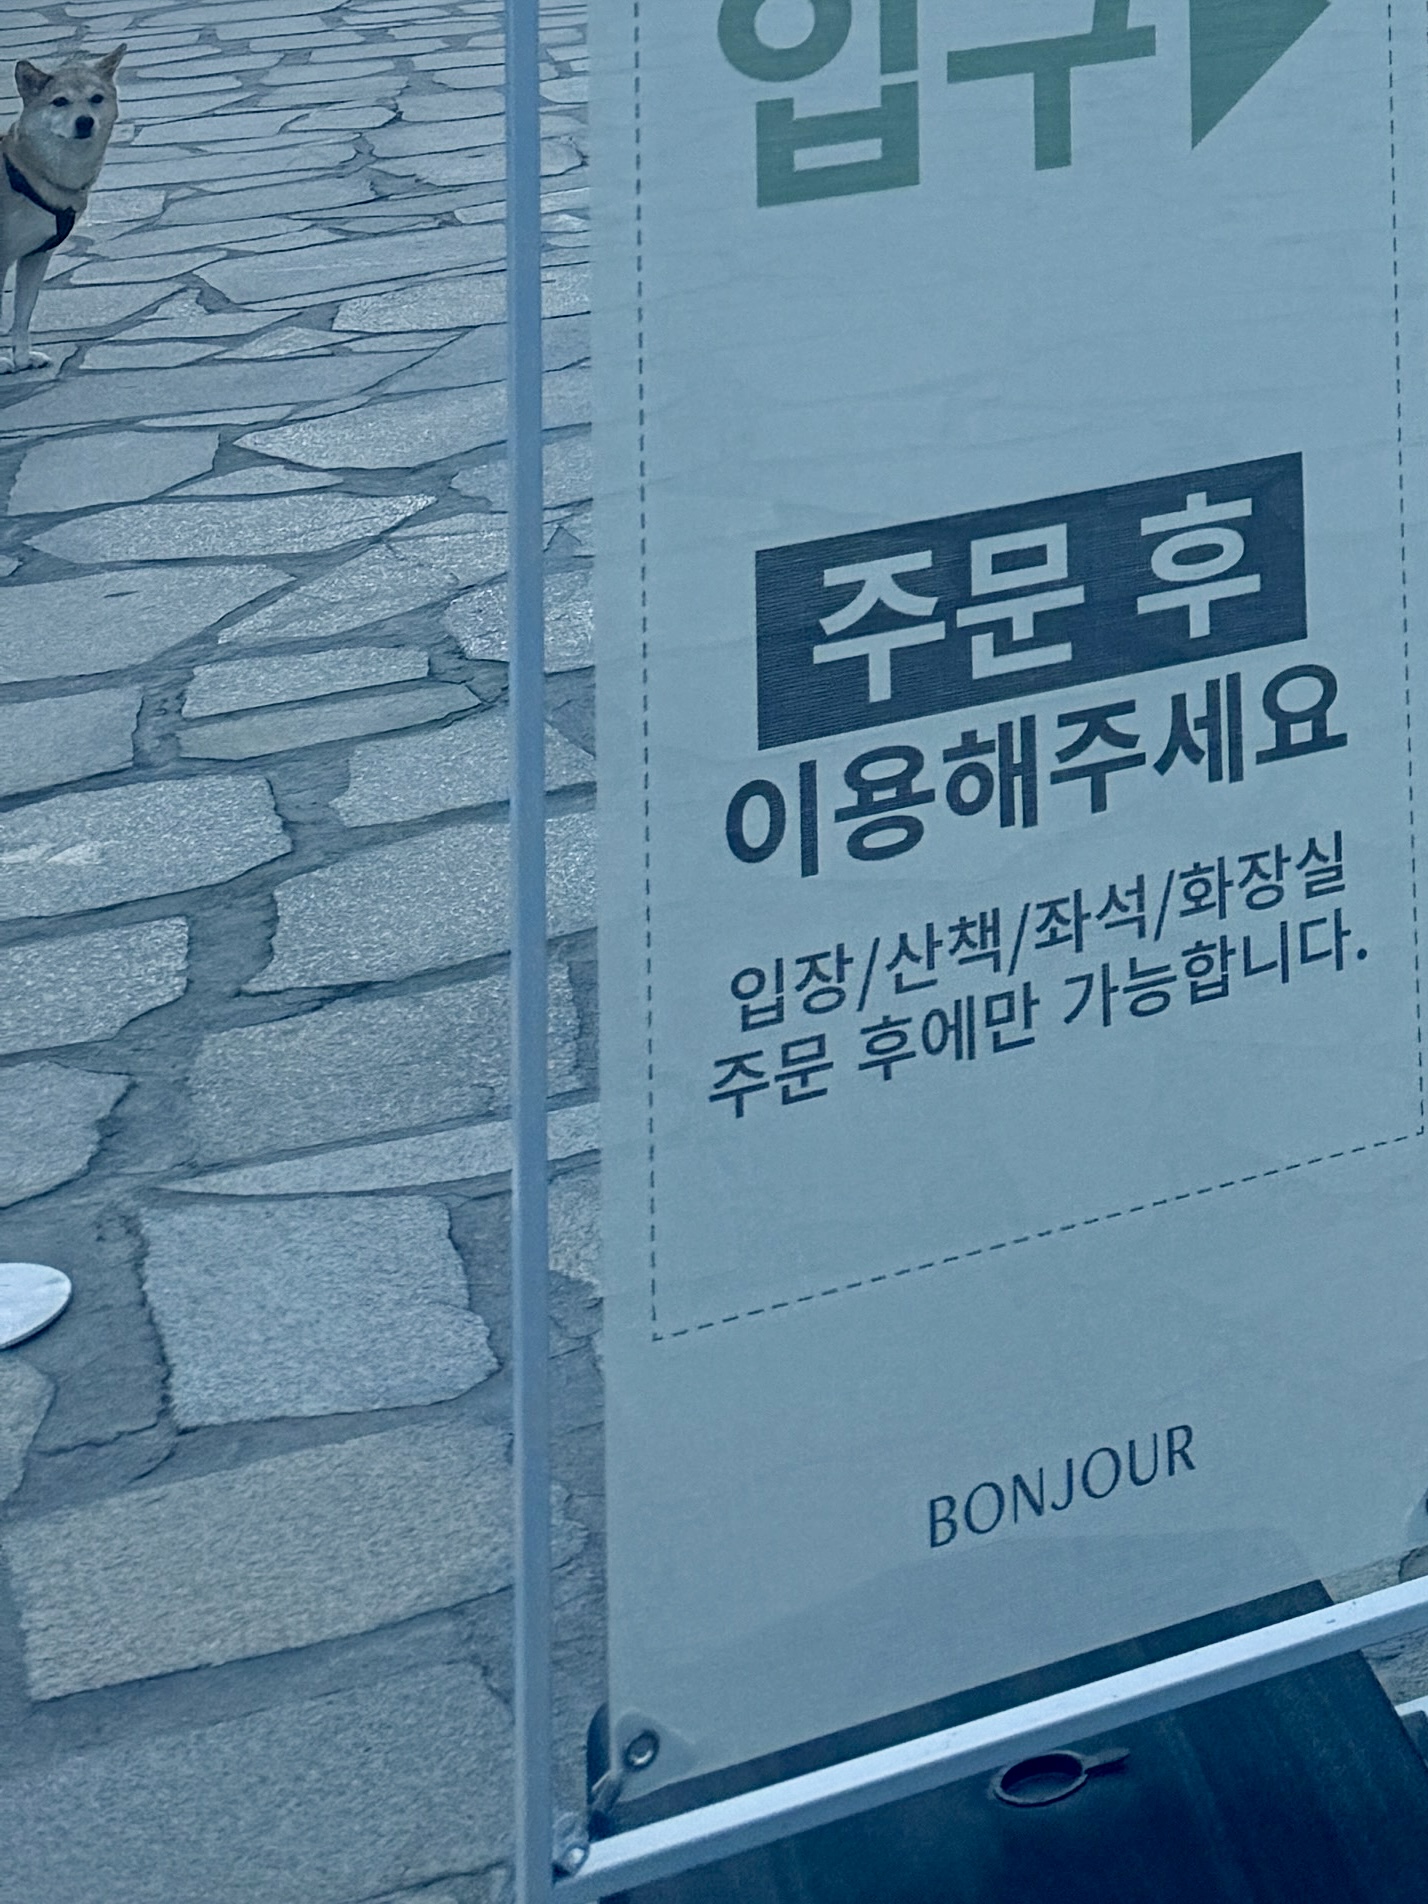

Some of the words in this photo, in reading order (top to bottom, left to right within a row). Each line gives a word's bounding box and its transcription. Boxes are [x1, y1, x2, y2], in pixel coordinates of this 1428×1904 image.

[812, 523, 1088, 703] 주문
[1137, 493, 1260, 638] 후
[725, 662, 1349, 878] 이용해주세요
[708, 1046, 834, 1119] 주문
[857, 982, 1040, 1081] 후에만
[1062, 911, 1368, 1032] 가능합니다.
[728, 832, 1347, 1032] 입장/산책/좌석/화장실
[927, 1422, 1196, 1550] BONJOUR
